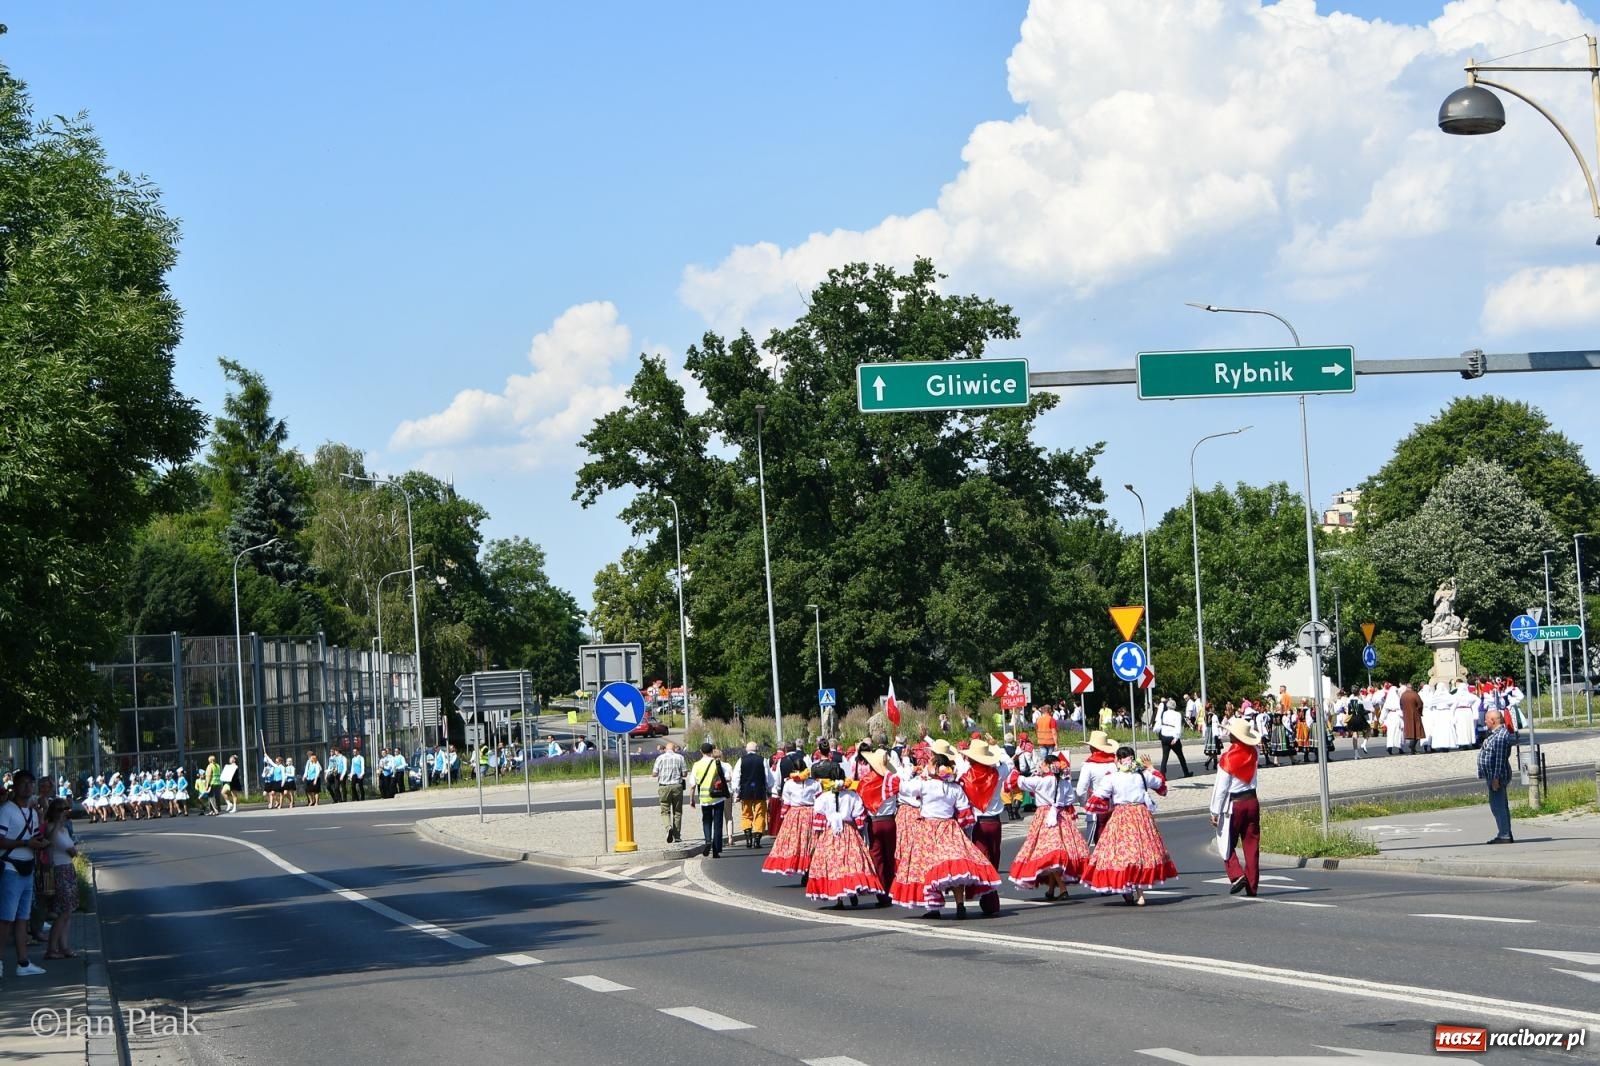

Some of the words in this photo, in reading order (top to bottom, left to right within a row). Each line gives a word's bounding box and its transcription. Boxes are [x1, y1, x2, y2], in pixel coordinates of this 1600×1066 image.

[926, 373, 1017, 396] Gliwice
[1214, 360, 1294, 390] Rybnik
[1539, 628, 1569, 639] Rybnik
